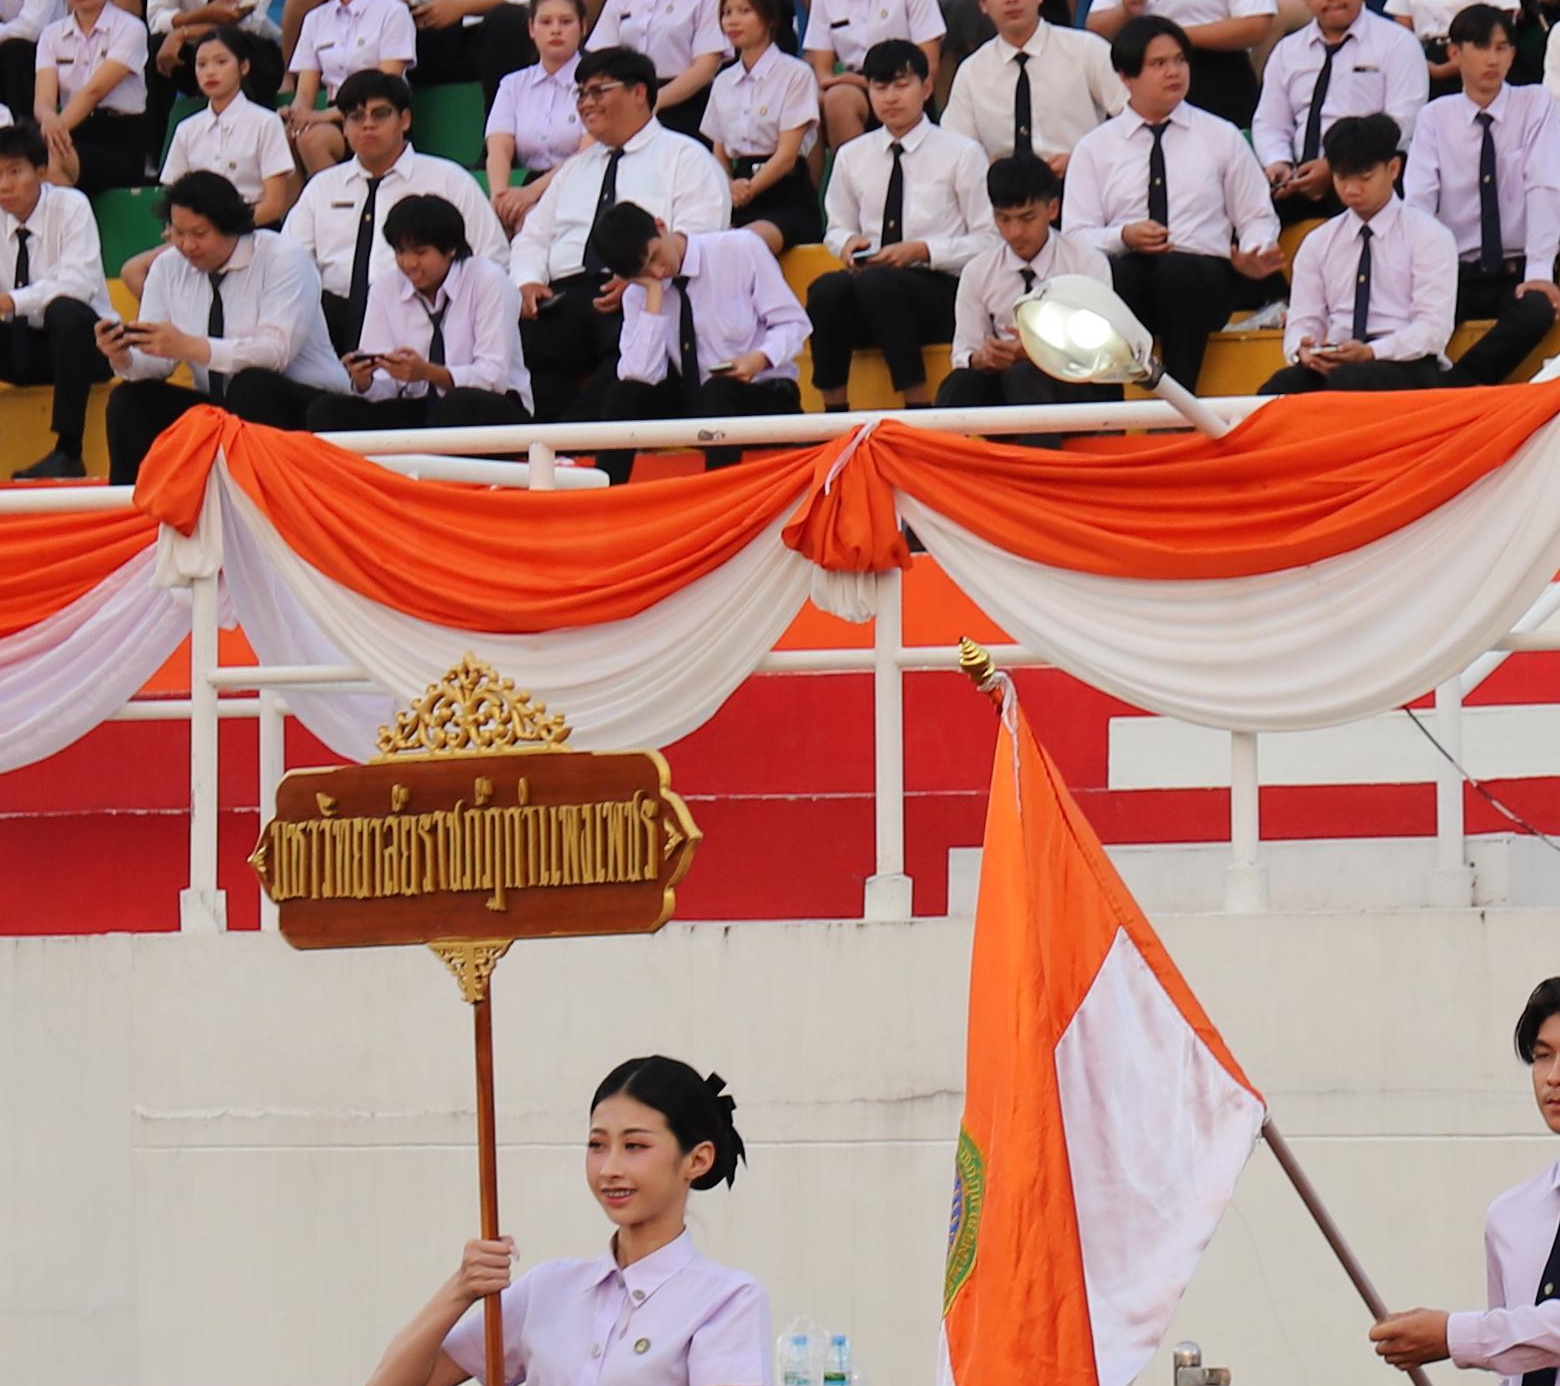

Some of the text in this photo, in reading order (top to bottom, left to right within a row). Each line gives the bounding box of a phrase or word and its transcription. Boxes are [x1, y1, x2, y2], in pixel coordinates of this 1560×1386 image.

[271, 777, 659, 911] มหาวิทยาลัยราชภัฏกำแพงเพชร
